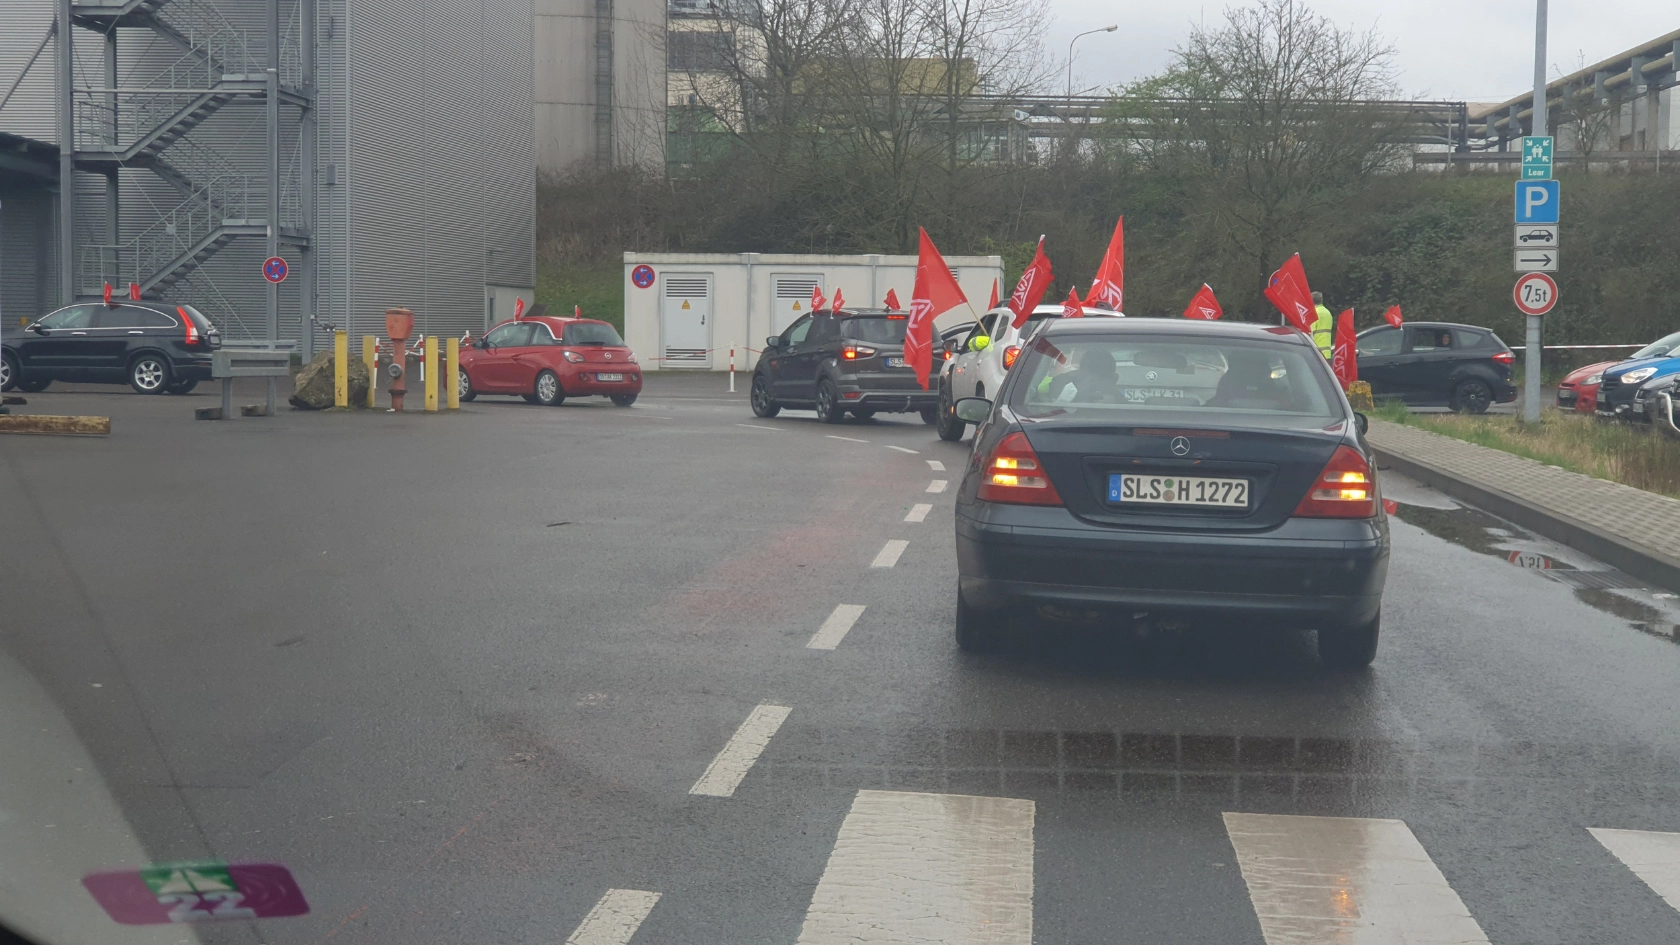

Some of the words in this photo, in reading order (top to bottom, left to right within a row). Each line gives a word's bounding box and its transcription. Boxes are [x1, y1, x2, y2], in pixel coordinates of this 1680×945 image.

[1528, 168, 1545, 177] Lear
[1525, 186, 1549, 218] P
[1126, 389, 1147, 401] SLS
[1122, 477, 1161, 500] SLS
[1177, 479, 1191, 501] H
[1195, 480, 1246, 504] 1272
